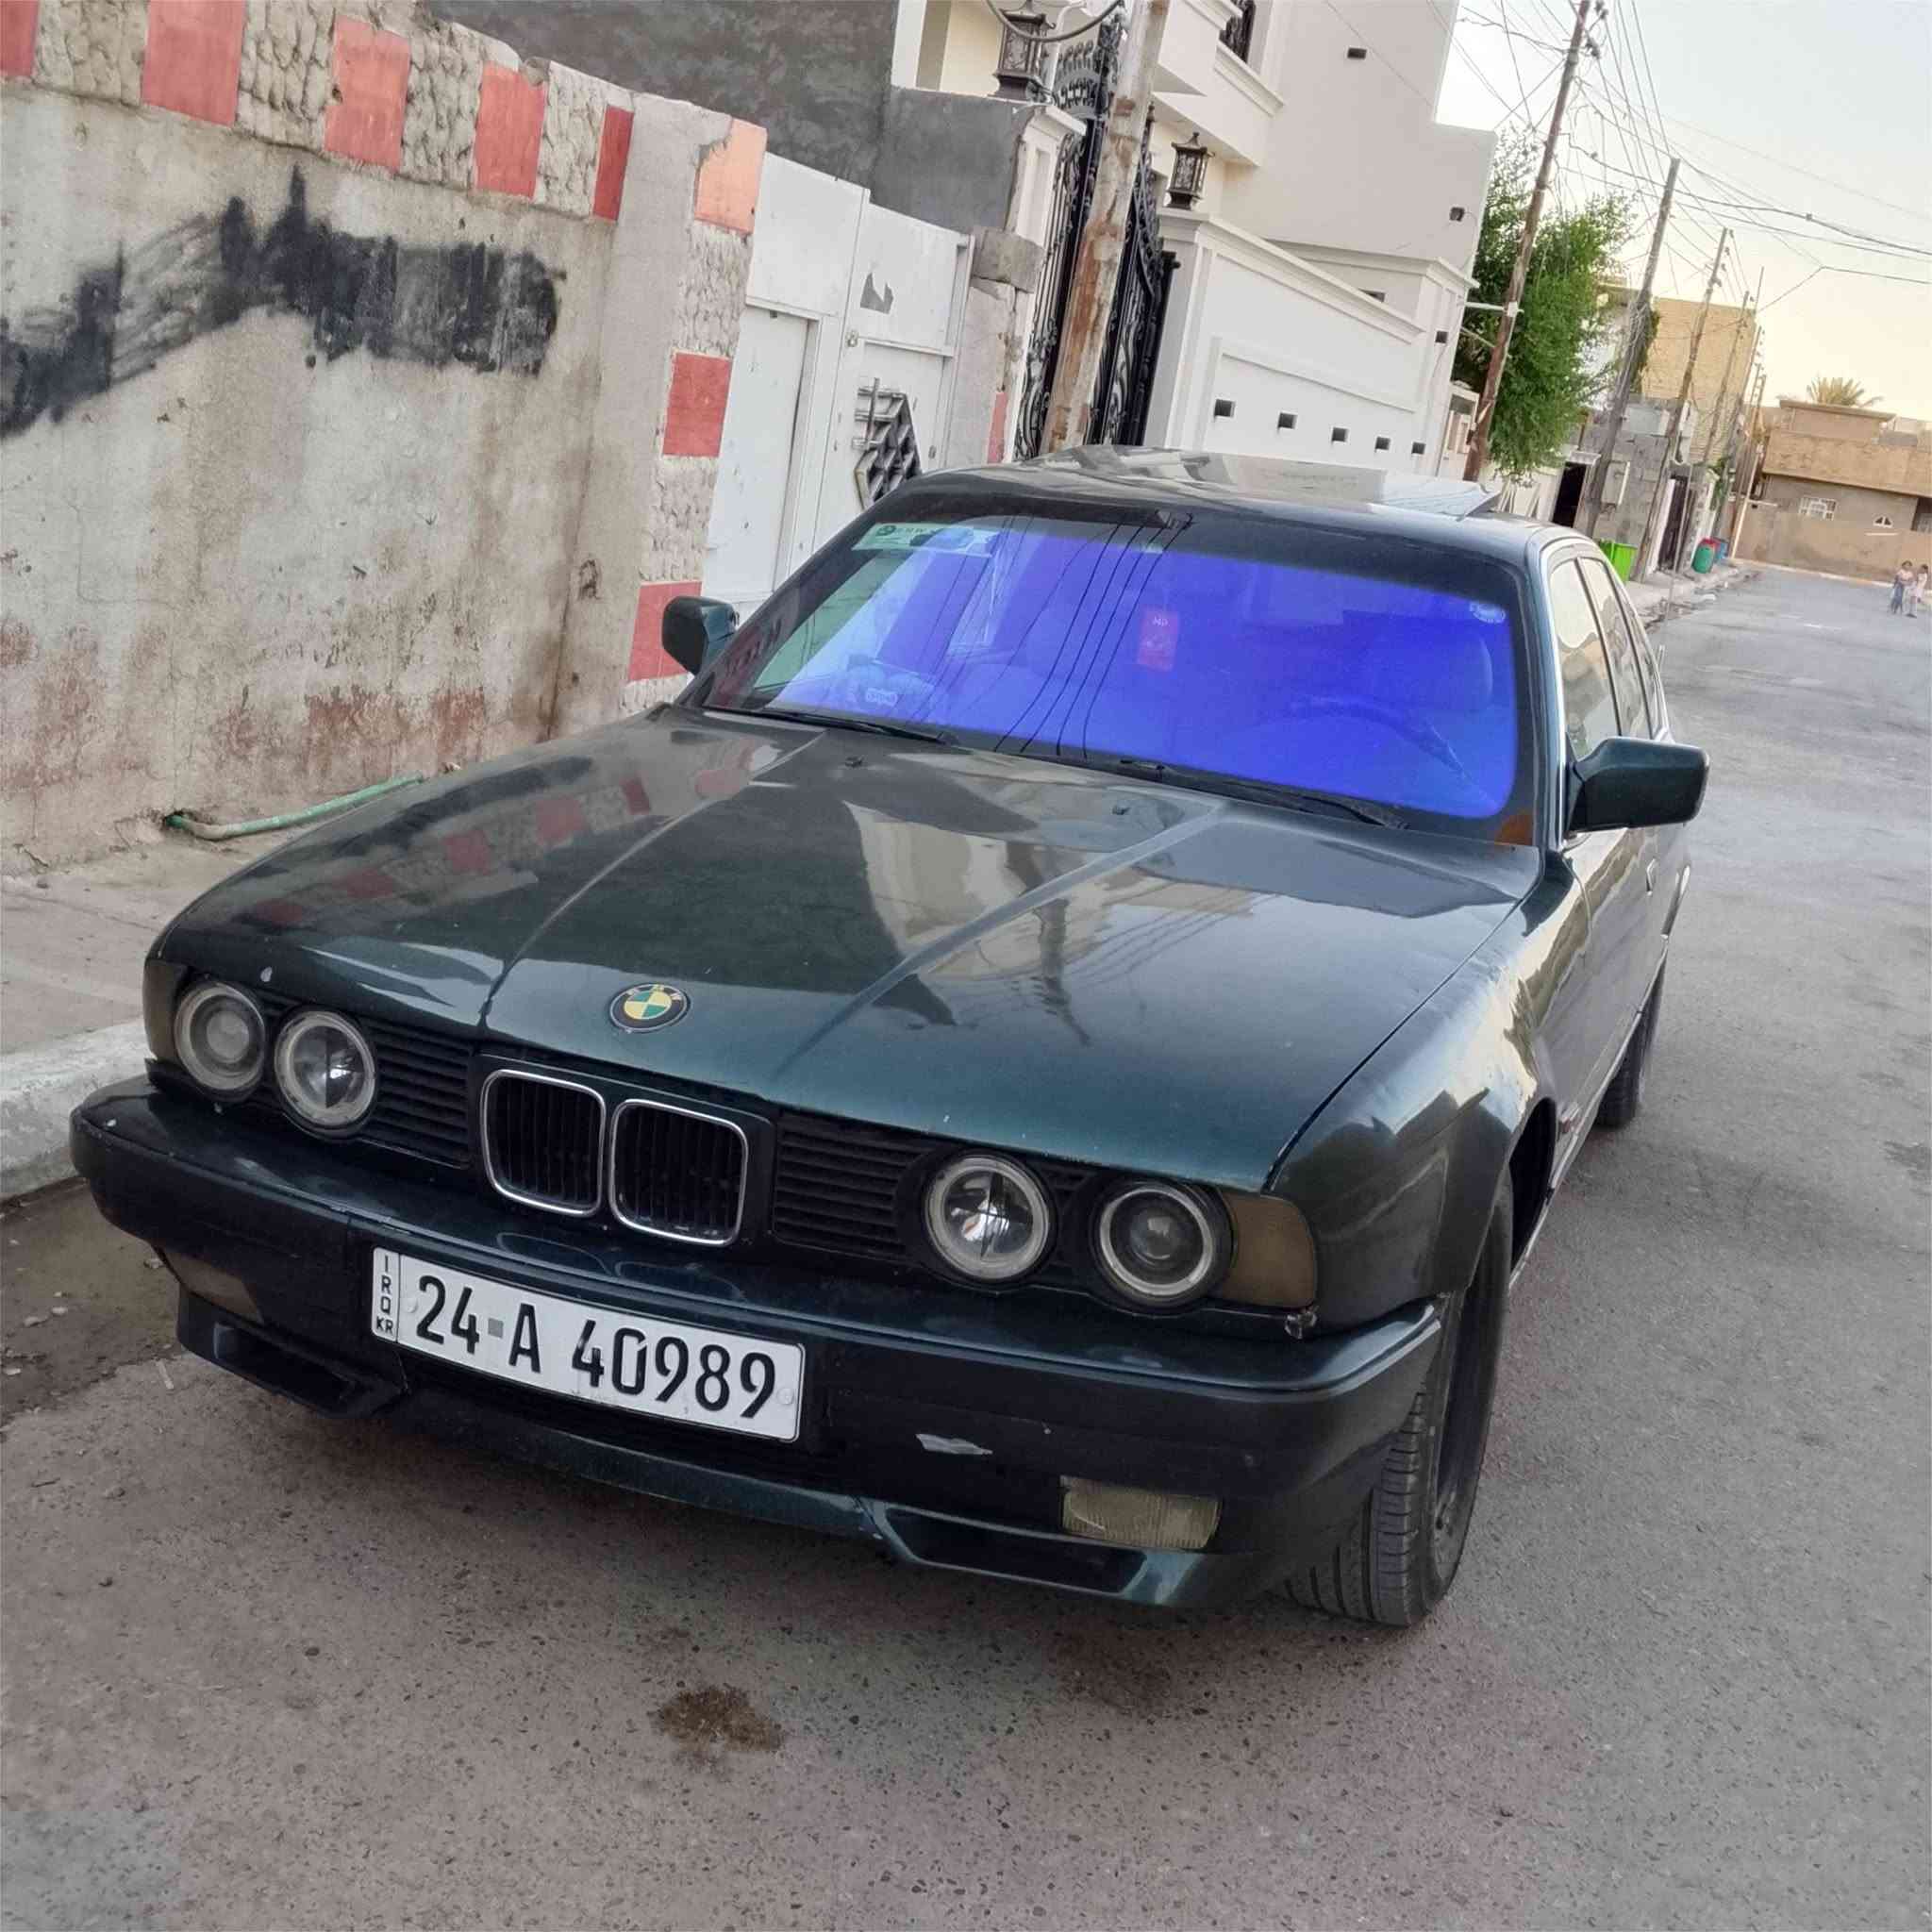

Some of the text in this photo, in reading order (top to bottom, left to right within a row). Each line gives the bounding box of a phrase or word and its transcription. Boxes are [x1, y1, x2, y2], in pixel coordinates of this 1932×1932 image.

[381, 1255, 392, 1316] IRQ
[376, 1316, 394, 1335] KR
[416, 1274, 775, 1419] 24 A 40989
